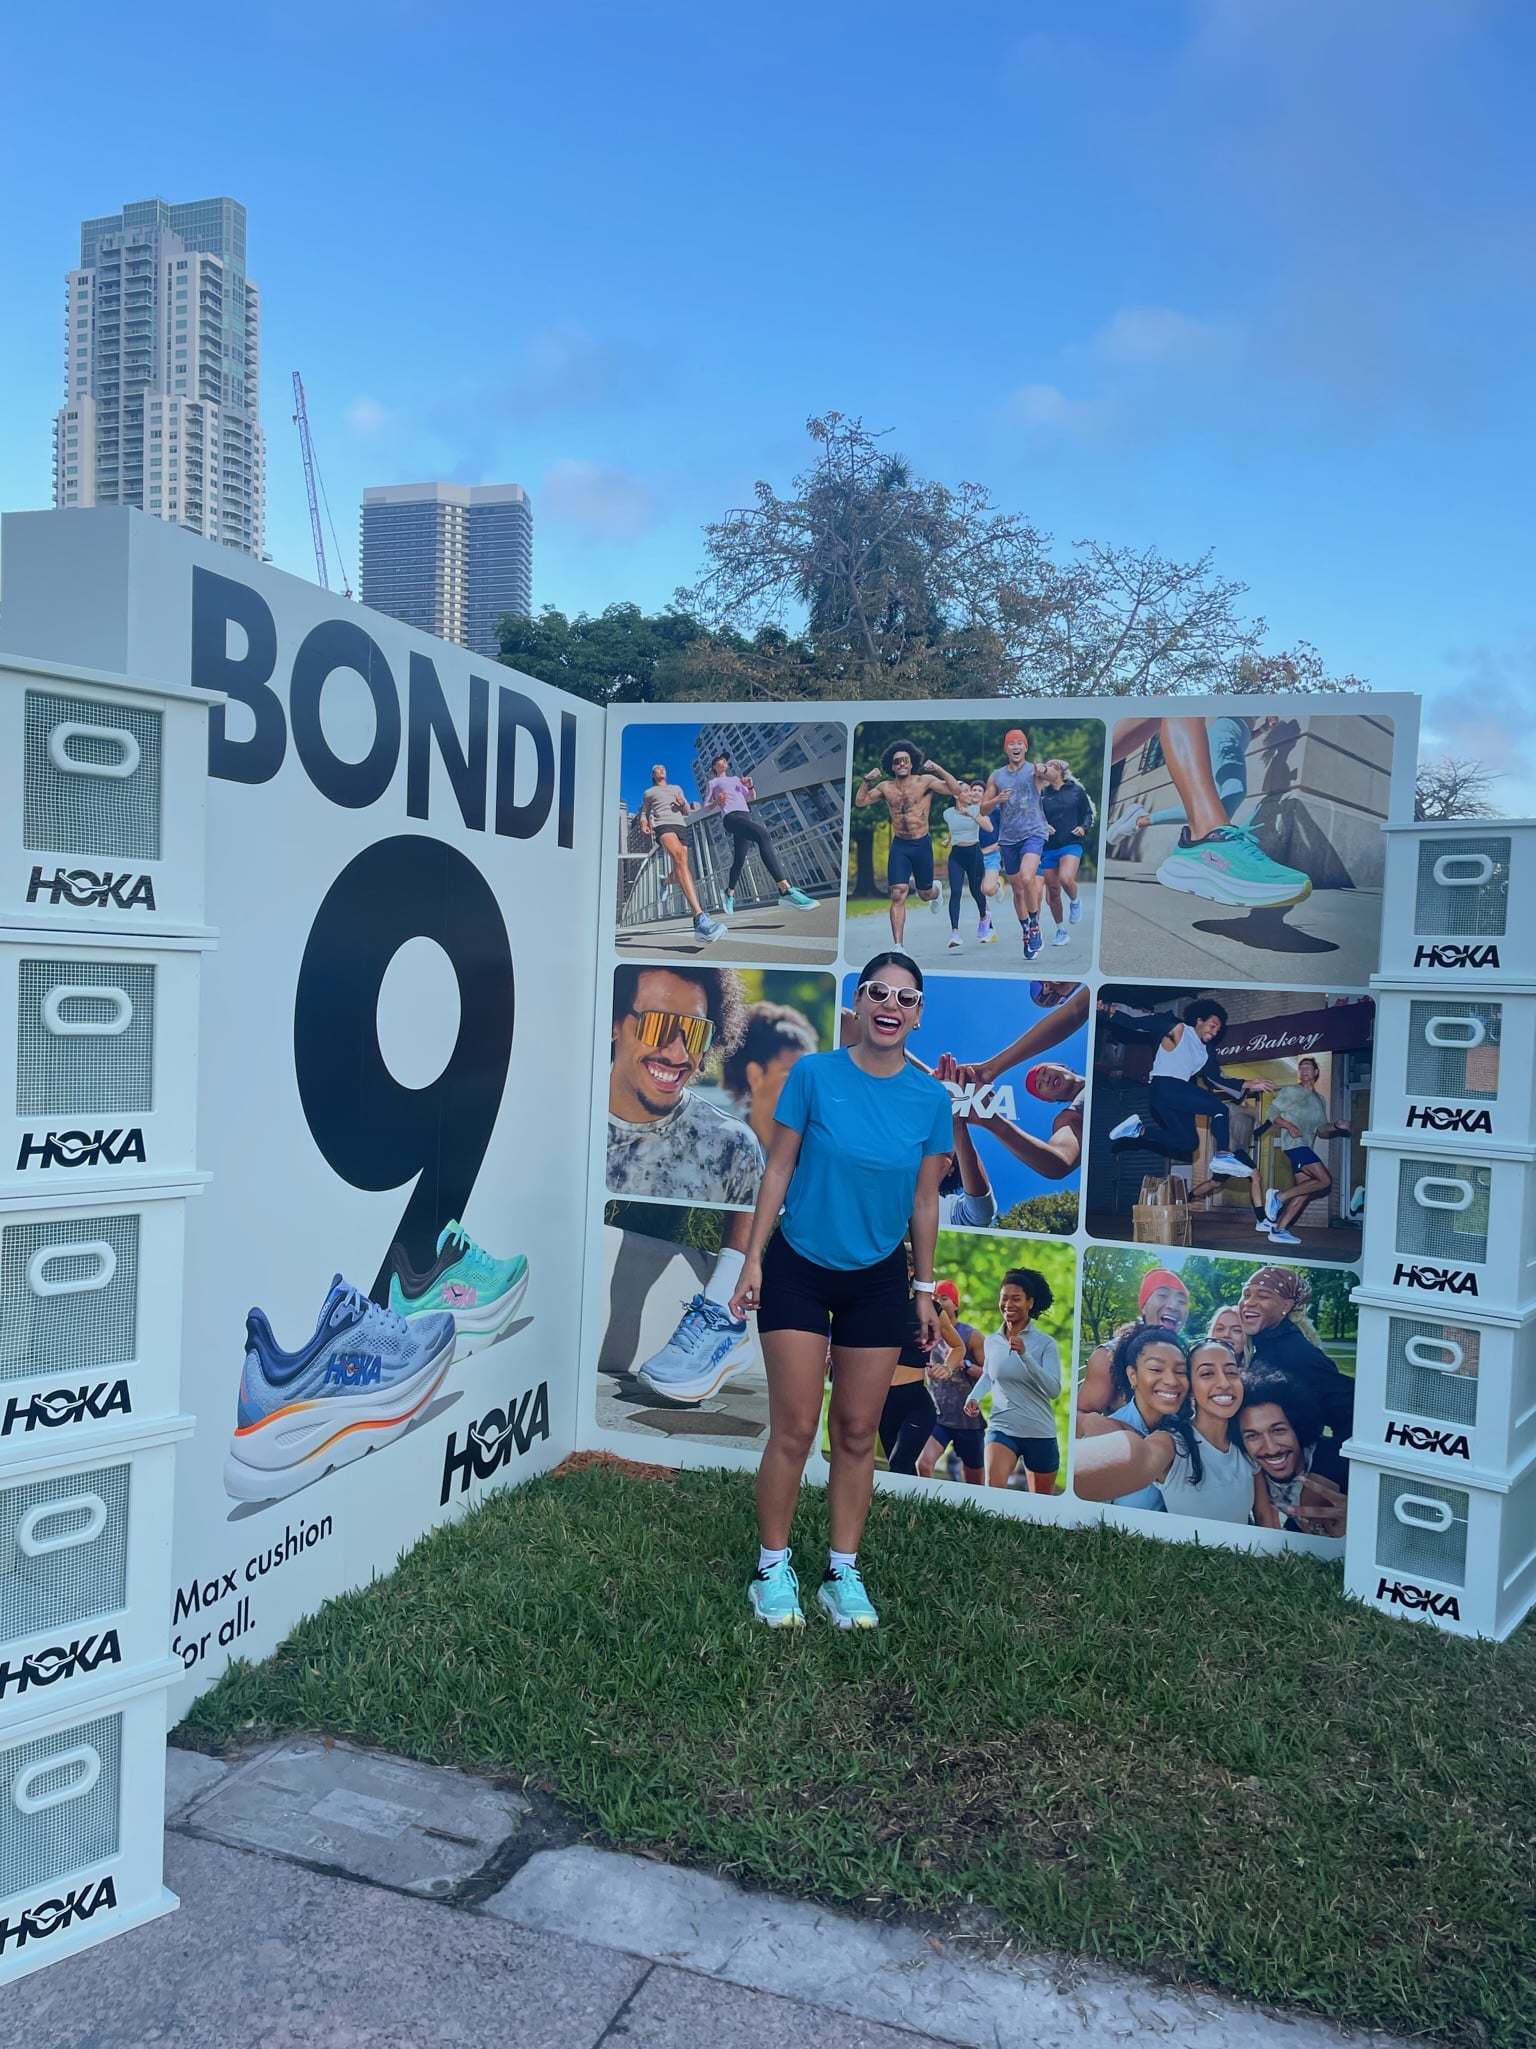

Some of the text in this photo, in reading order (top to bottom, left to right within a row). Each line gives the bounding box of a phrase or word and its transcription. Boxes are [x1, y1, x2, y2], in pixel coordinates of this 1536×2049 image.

[192, 564, 577, 850] BONDI
[24, 865, 157, 911] HOKA
[1413, 944, 1501, 969] HOKA
[1246, 1031, 1325, 1051] Bakery
[293, 833, 515, 1308] 9
[1405, 1105, 1493, 1134] HOKA
[15, 1127, 148, 1171] HOKA
[438, 1280, 478, 1308] HOKA
[1392, 1263, 1479, 1297] HOKA
[323, 1352, 383, 1387] HOKA
[0, 1378, 132, 1437] HOKA
[439, 1380, 551, 1508] HOKA
[1384, 1421, 1471, 1461] HOKA
[172, 1514, 334, 1627] Max cushion
[218, 1595, 257, 1648] all.
[1375, 1577, 1461, 1622] HOKA
[0, 1628, 123, 1701] HOKA
[0, 1875, 118, 1956] HOKA
